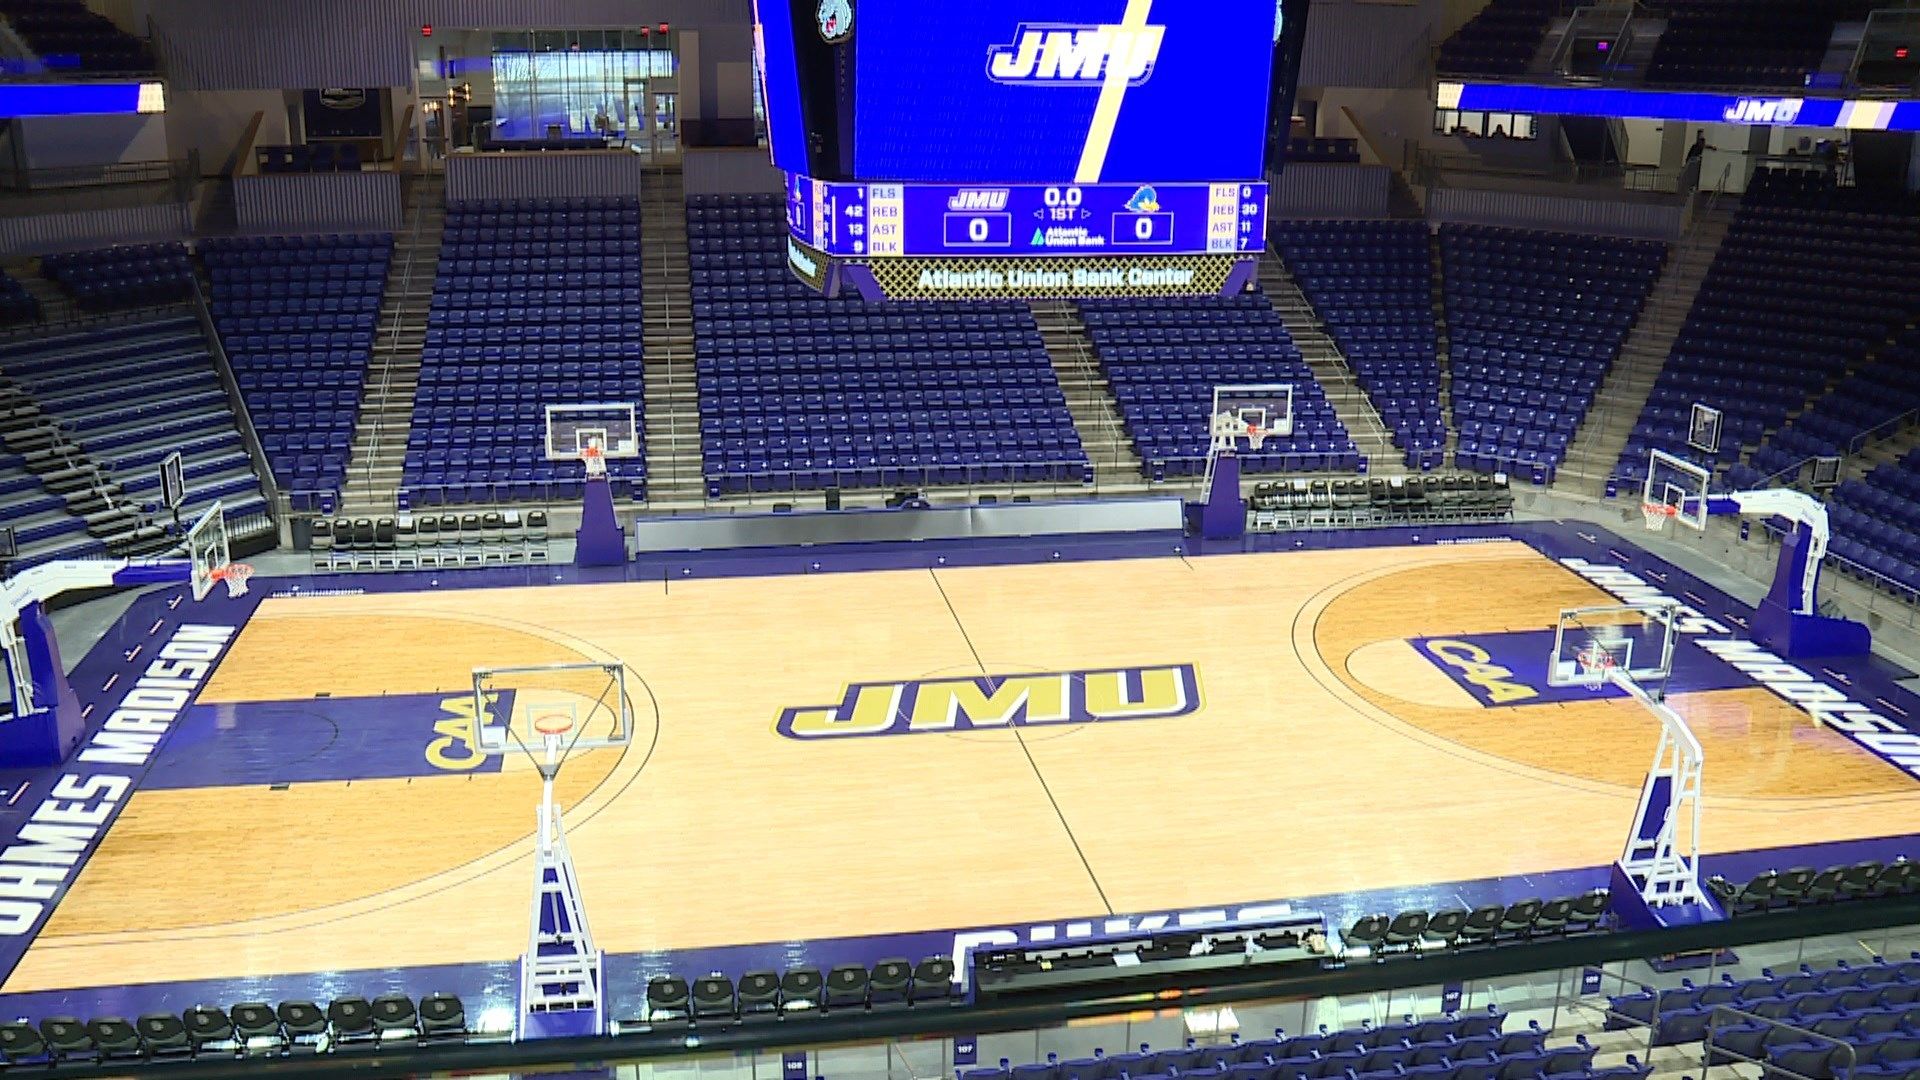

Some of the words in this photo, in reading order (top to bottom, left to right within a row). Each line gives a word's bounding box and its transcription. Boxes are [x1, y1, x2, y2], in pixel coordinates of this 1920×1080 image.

[988, 24, 1164, 84] JMU
[1724, 97, 1803, 124] JMU
[857, 187, 864, 200] 1
[871, 187, 896, 199] FLS
[948, 189, 1010, 211] JMU
[1044, 187, 1082, 207] 0.0
[1215, 187, 1236, 197] FLS
[1242, 186, 1251, 198] 0
[845, 204, 864, 218] 42
[872, 206, 898, 218] REB
[1050, 208, 1076, 220] 1ST
[1213, 205, 1234, 215] REB
[872, 224, 896, 235] AST
[969, 218, 988, 241] 0
[1046, 226, 1089, 237] Atlantic
[1135, 217, 1153, 239] 0
[1212, 222, 1233, 233] AST
[872, 242, 897, 252] BLK
[1046, 235, 1076, 246] Union
[1078, 234, 1105, 246] Bank
[1211, 239, 1232, 250] BLK
[1240, 238, 1248, 251] 7
[919, 267, 1003, 288] Atlantic
[1007, 267, 1068, 288] Union
[1073, 266, 1124, 287] Bank
[1128, 267, 1194, 286] Center
[1426, 640, 1539, 702] CAA
[77, 623, 236, 765] MADISON
[776, 664, 1200, 740] JMU
[425, 693, 499, 770] CAA
